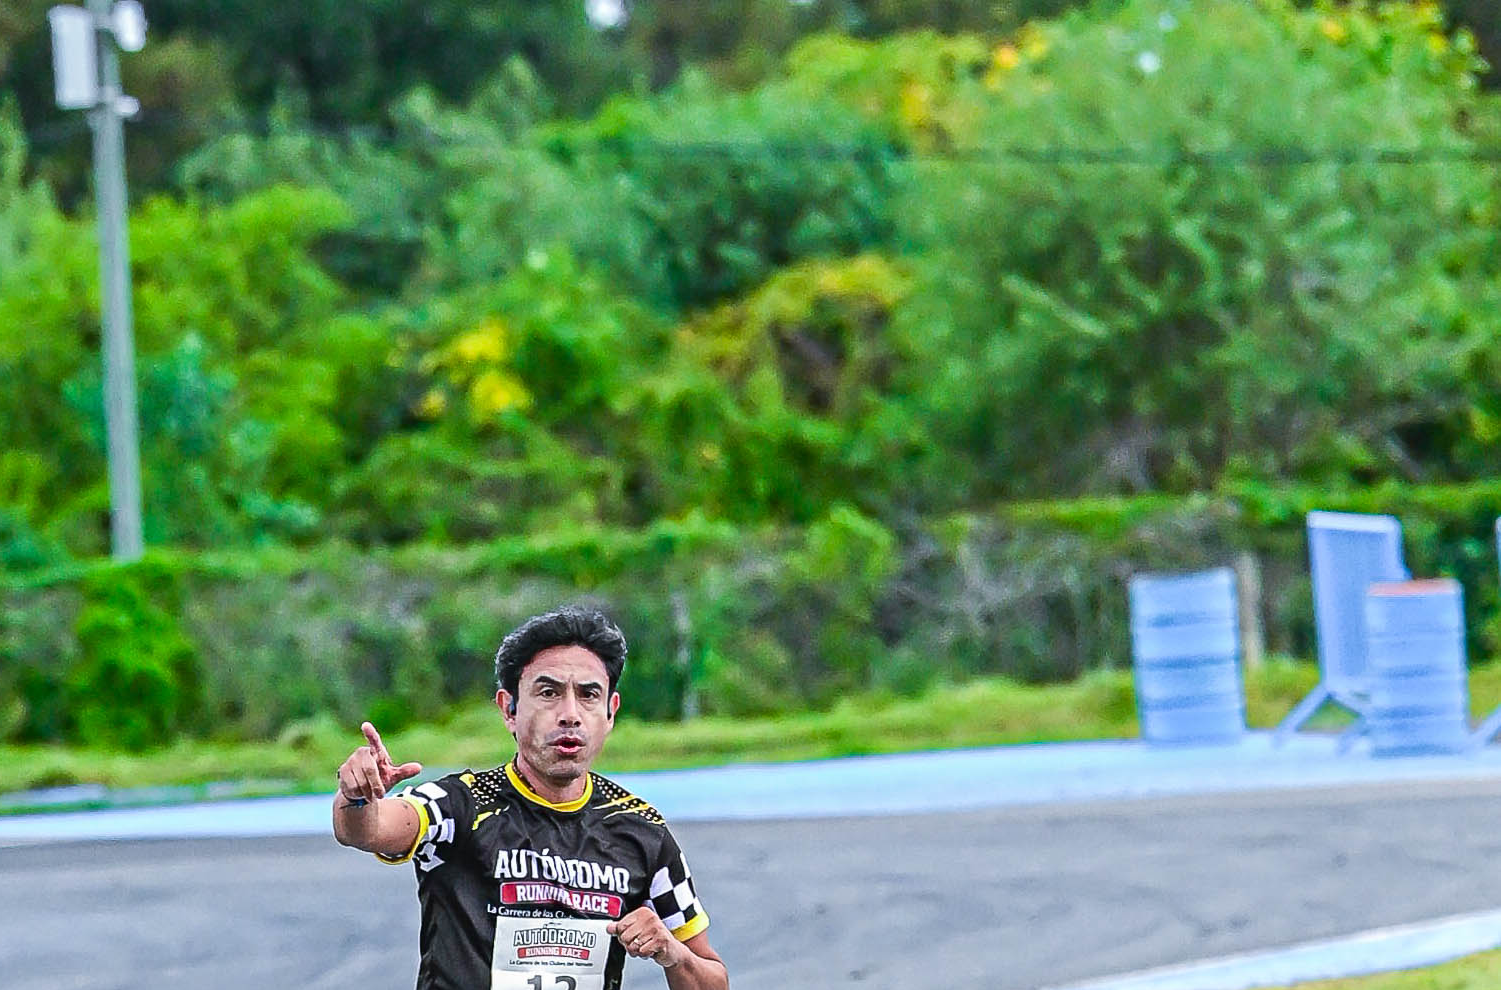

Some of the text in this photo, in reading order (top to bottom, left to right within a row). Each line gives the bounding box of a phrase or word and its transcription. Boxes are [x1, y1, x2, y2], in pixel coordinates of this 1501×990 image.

[487, 903, 497, 913] La
[498, 906, 531, 917] Carrera
[532, 909, 542, 918] de
[572, 893, 609, 914] RACE
[513, 923, 597, 949] AUTÓDROMO
[561, 948, 583, 958] RACE
